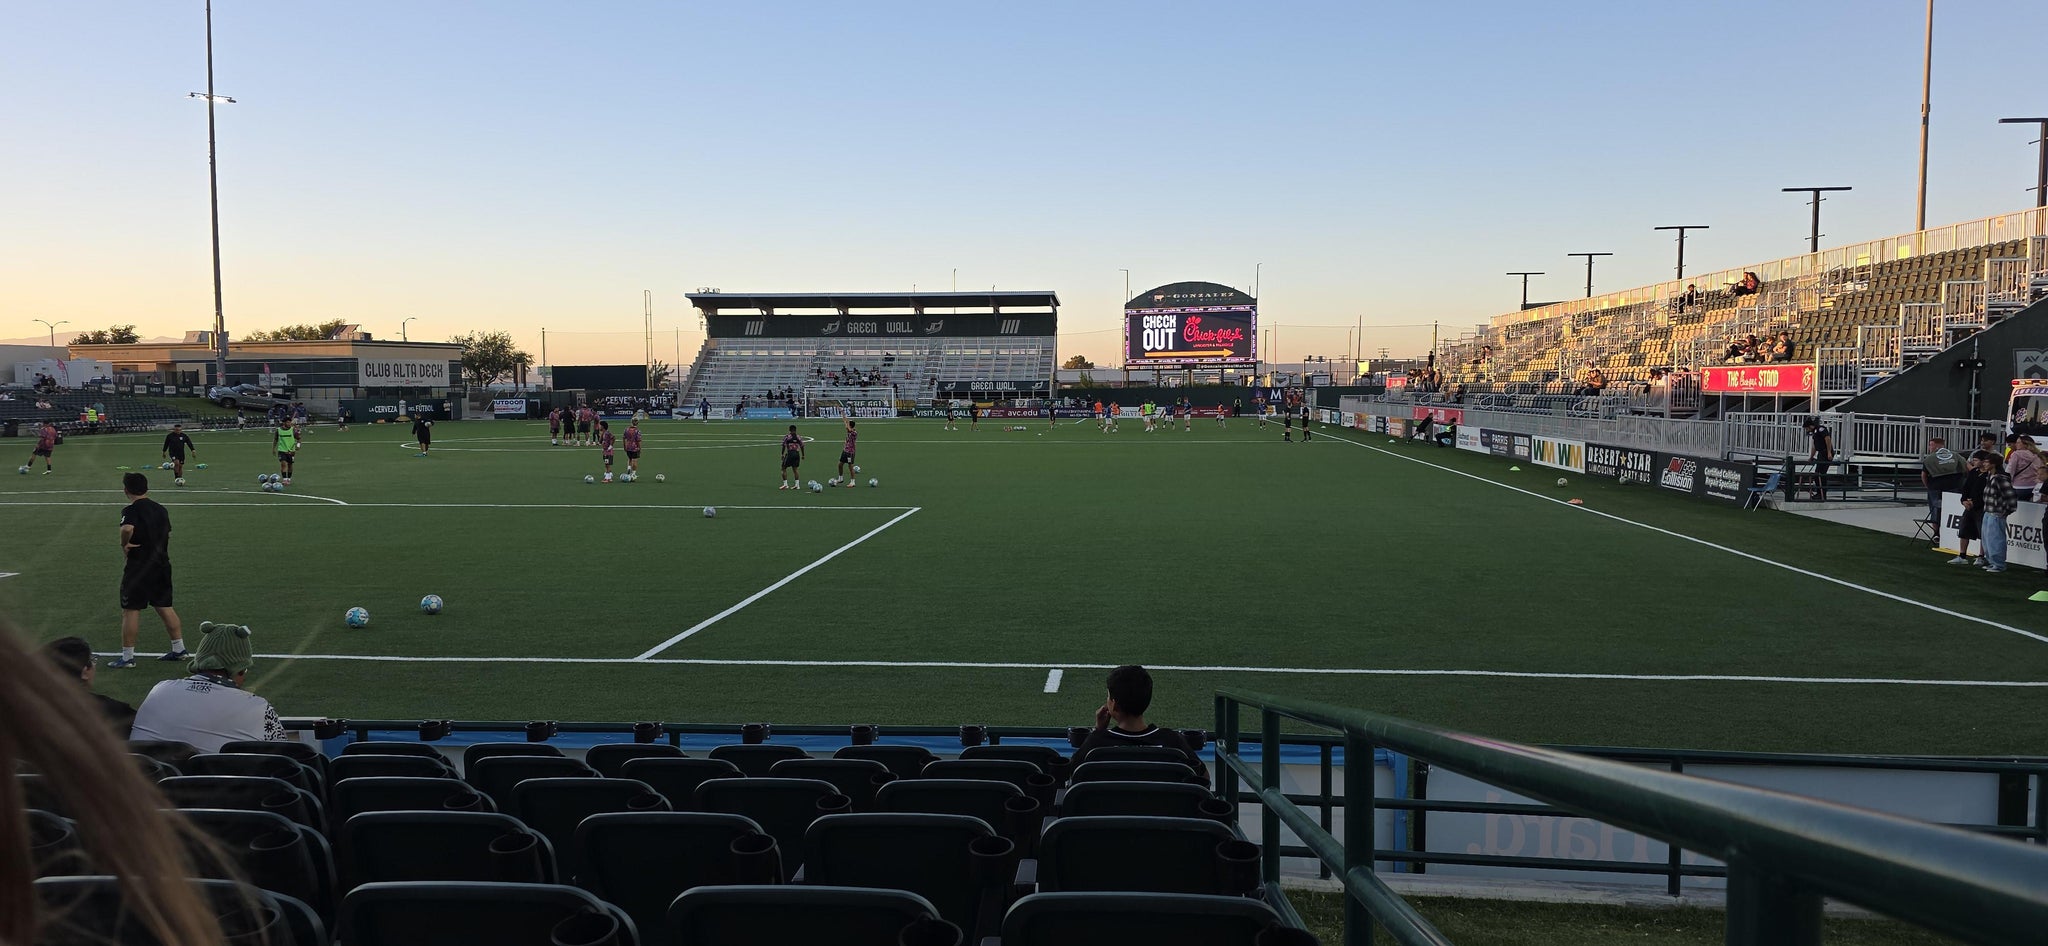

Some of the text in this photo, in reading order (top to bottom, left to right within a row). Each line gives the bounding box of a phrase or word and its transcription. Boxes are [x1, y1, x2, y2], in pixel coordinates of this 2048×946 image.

[847, 322, 877, 333] GREEN
[886, 322, 913, 333] WALL
[1143, 315, 1176, 328] CHECK
[1143, 328, 1176, 351] OUT
[2023, 355, 2040, 363] AV
[365, 362, 443, 378] CLUB ALTA DECK
[1727, 371, 1739, 387] THE
[1758, 369, 1779, 387] STAND
[971, 382, 1016, 390] GREEN WALL
[1270, 389, 1282, 400] M
[374, 405, 398, 413] CERVEZA
[1533, 439, 1555, 464] WM
[1558, 442, 1583, 469] WM
[1587, 446, 1651, 472] DESERT STAR
[1589, 463, 1651, 483] LIMOUSINE PARTY BUS
[1661, 469, 1693, 490] Collision
[2015, 541, 2041, 551] ANGELES
